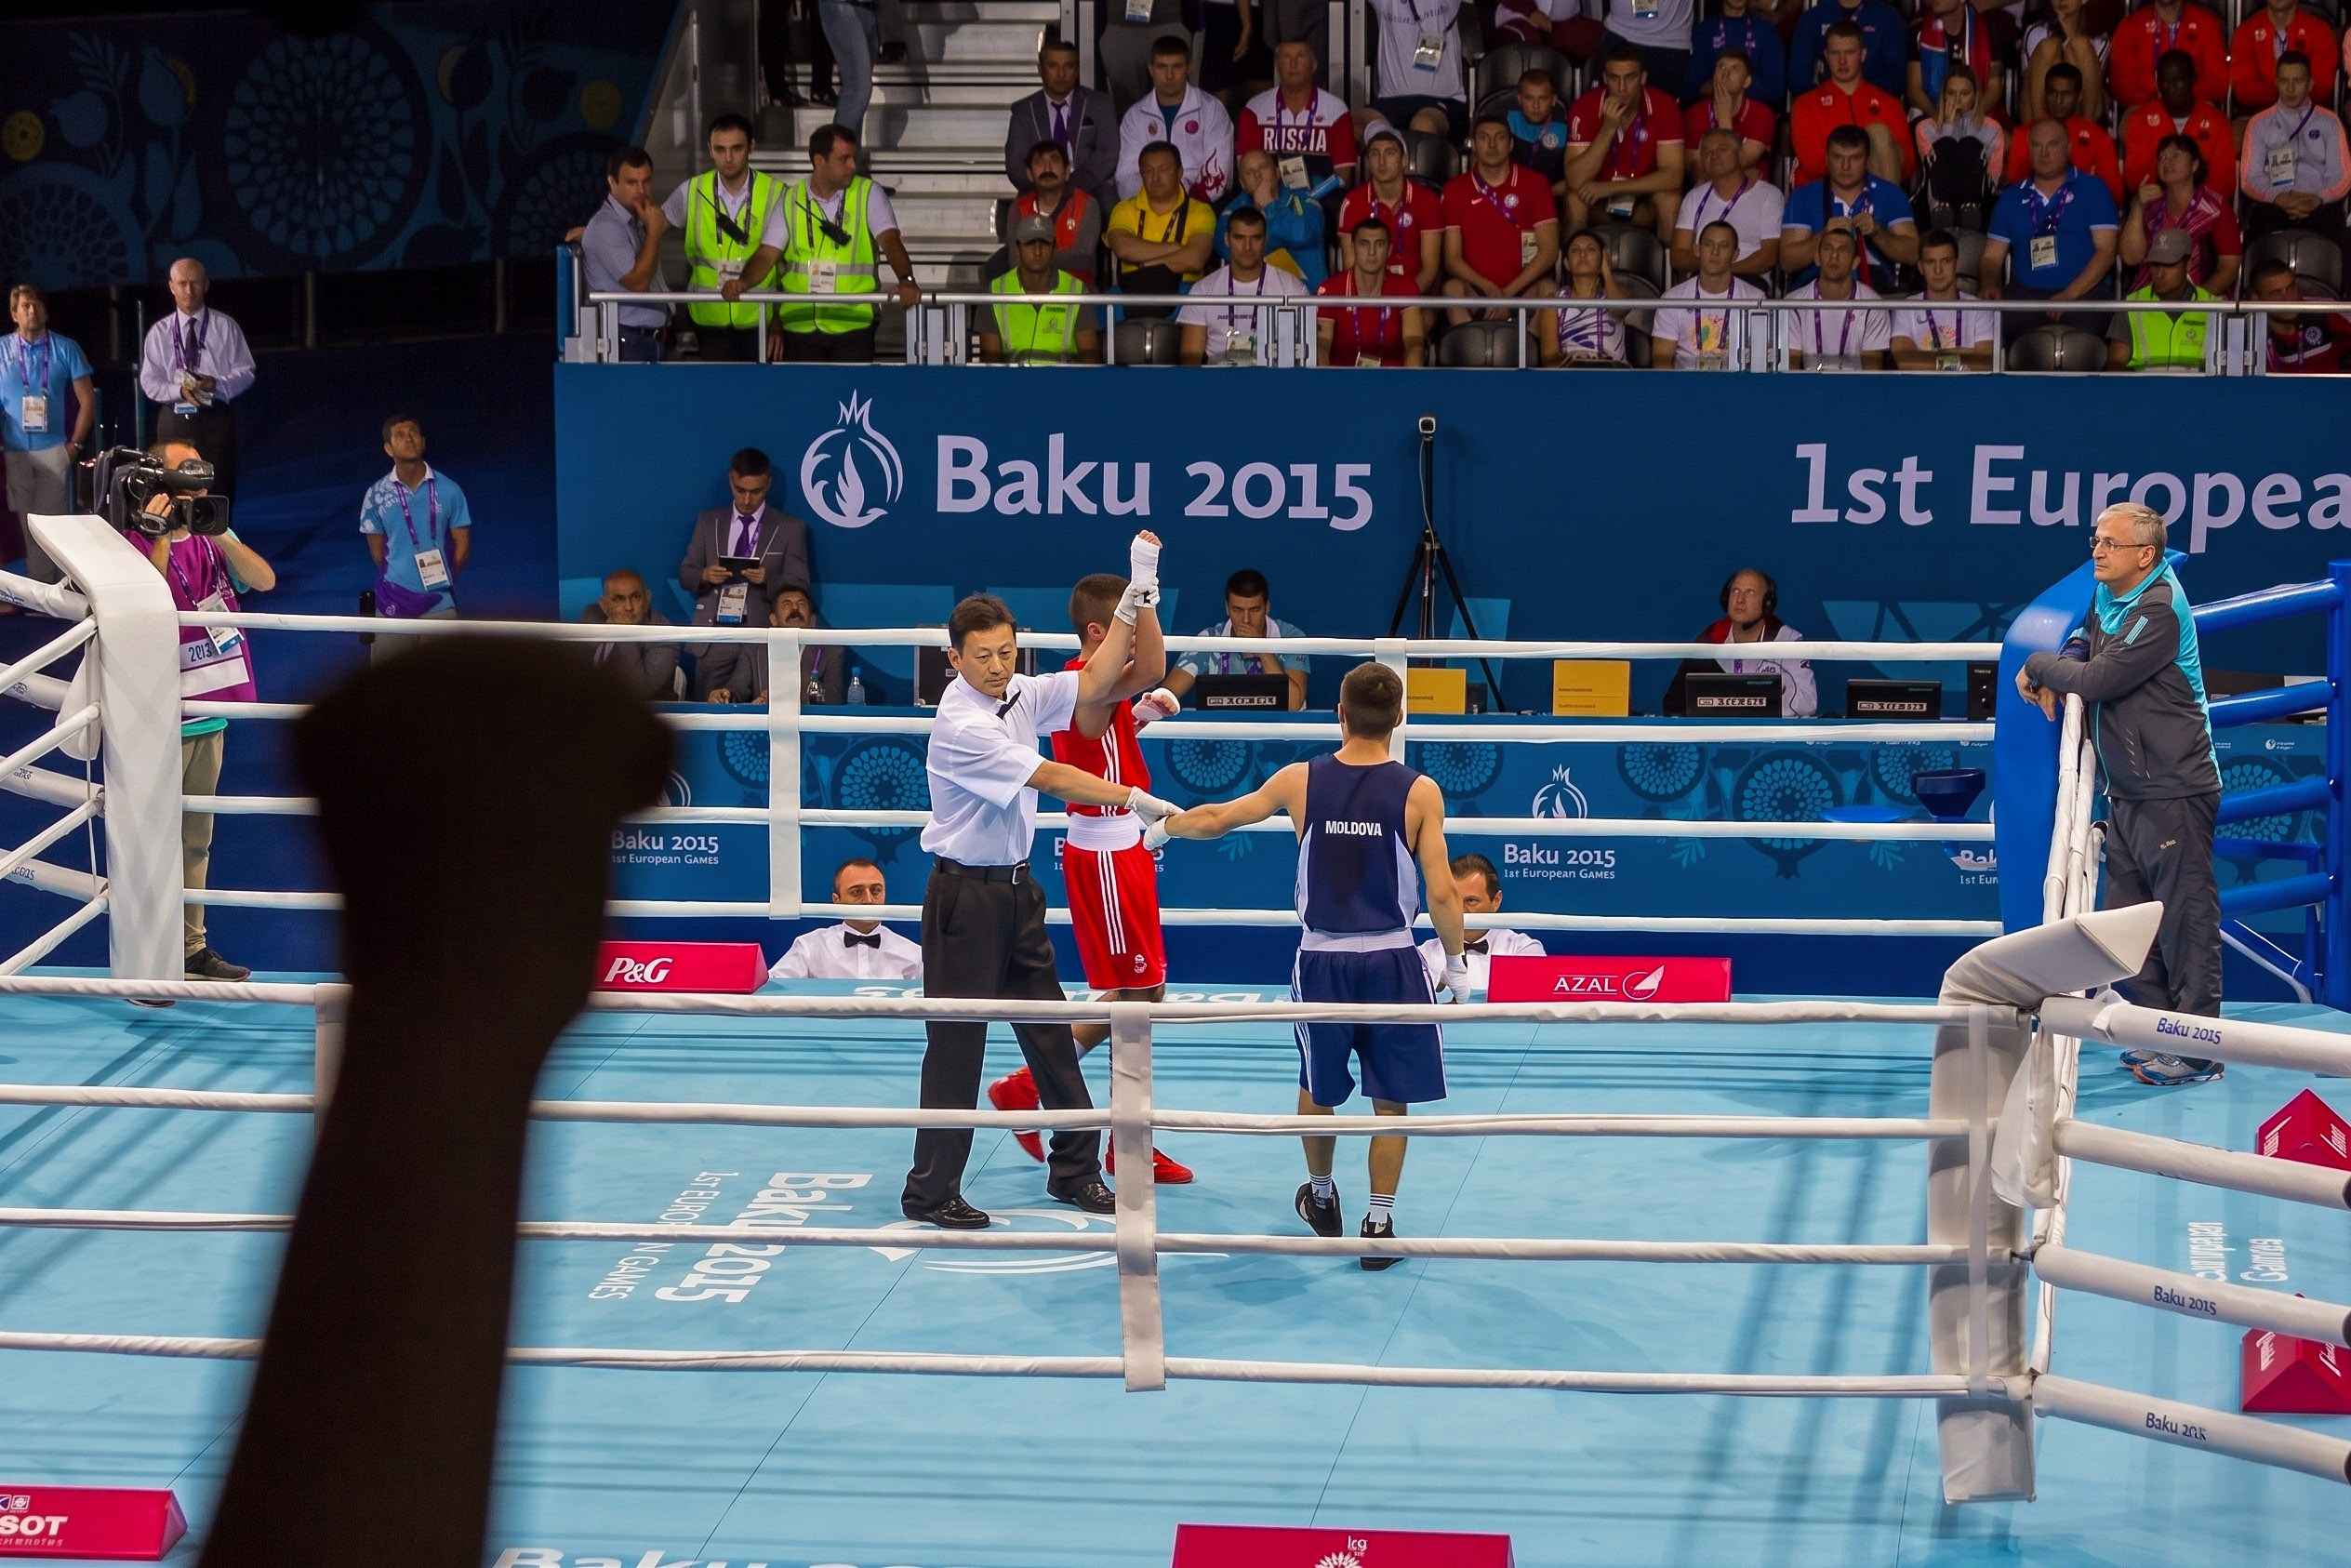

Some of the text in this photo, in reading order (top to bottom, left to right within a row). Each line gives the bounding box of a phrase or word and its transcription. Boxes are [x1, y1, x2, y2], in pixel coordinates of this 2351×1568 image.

[936, 432, 1374, 532] Baku 2015
[1791, 443, 1933, 526] 1st
[1325, 820, 1383, 837] MOLDOVA
[612, 830, 719, 854] Baku 2015
[629, 853, 681, 866] European
[1504, 843, 1616, 868] Baku 2015
[1522, 868, 1576, 881] European
[604, 957, 673, 983] P&G
[1553, 977, 1617, 992] AZAL
[2157, 1017, 2223, 1045] Baku 2015
[2154, 1285, 2217, 1316] Baku 2015
[2145, 1412, 2178, 1435] Baku
